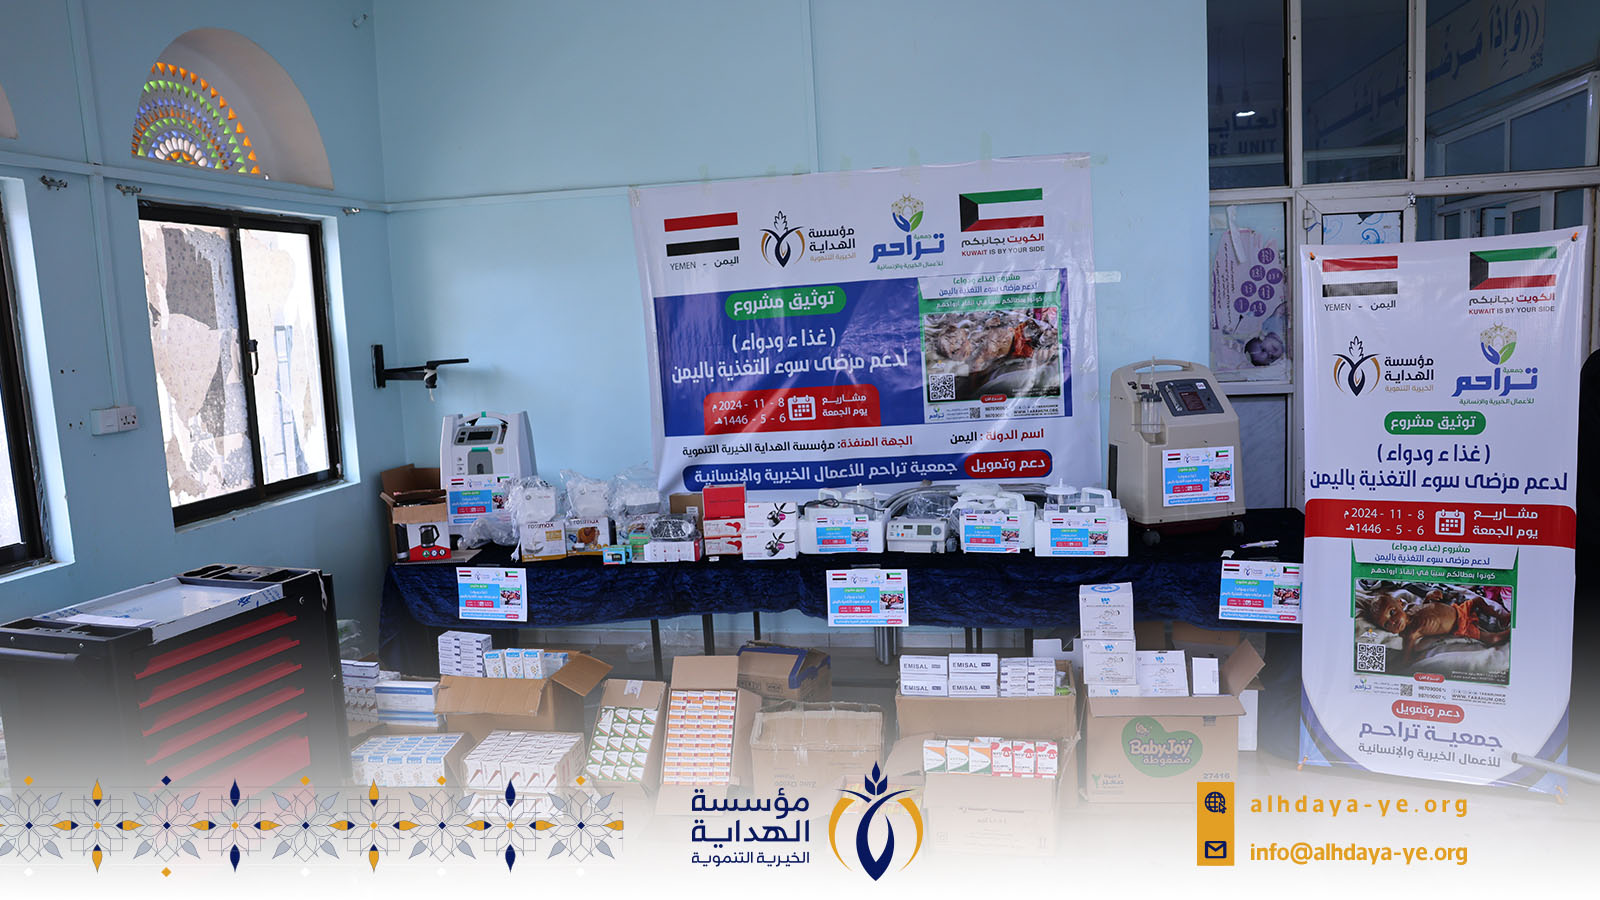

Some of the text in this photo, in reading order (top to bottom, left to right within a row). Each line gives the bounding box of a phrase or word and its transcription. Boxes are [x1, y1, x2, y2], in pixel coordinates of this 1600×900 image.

[1239, 140, 1277, 154] UNIT
[808, 225, 855, 238] مؤسسة
[809, 238, 856, 253] الهداية
[961, 233, 1044, 248] الكويت بجانبكم
[869, 233, 945, 264] تراحم
[961, 249, 987, 257] KUWAIT
[670, 256, 739, 272] YEMEN اليمن
[733, 289, 835, 316] توثيق مشروع
[1324, 300, 1396, 312] YEMEN اليمن
[1469, 293, 1555, 306] الكويت بجانبكم
[870, 348, 908, 373] لدعم
[1384, 354, 1434, 369] مؤسسة
[672, 361, 714, 383] باليمن
[717, 357, 770, 381] التغذية
[774, 358, 809, 378] سوء
[1503, 366, 1524, 374] جمعية
[1384, 369, 1434, 385] الهداية
[1451, 366, 1538, 397] تراحم
[754, 398, 765, 409] 11
[777, 397, 785, 407] 8
[822, 392, 867, 405] مشاريع
[760, 414, 767, 424] 5
[779, 413, 786, 423] 6
[822, 407, 868, 417] يوم الجمعة
[1390, 416, 1476, 431] توثيق مشروع
[881, 435, 913, 447] الجهة
[950, 432, 977, 445] اليمن
[986, 429, 1018, 443] الدولة
[1020, 428, 1044, 441] اسم
[682, 444, 719, 458] التنموية
[721, 443, 752, 455] الخيرية
[754, 441, 790, 454] الهداية
[793, 440, 835, 452] مؤسسة
[814, 463, 864, 483] للأعمال
[869, 461, 906, 479] تراحم
[910, 460, 957, 475] جمعية
[971, 458, 1046, 474] دعم وتمويل
[764, 466, 810, 484] الخيرية
[1310, 468, 1355, 490] باليمن
[1359, 469, 1416, 491] التغذية
[1421, 475, 1460, 493] سوء
[1524, 472, 1568, 495] لدعم
[1390, 509, 1402, 519] 11
[1417, 510, 1425, 520] 8
[1473, 507, 1538, 521] مشاريع
[1395, 524, 1402, 535] 5
[1417, 525, 1424, 536] 6
[1472, 525, 1538, 539] يوم الجمعة
[1391, 543, 1470, 553] مشروع (غذاء ودواء)
[1375, 553, 1396, 562] باليمن
[1398, 554, 1424, 563] التغذية
[1426, 556, 1443, 564] سوء
[1471, 557, 1490, 566] لدعم
[1395, 703, 1460, 718] دعم وتمويل
[1359, 721, 1503, 752] جمعية تراحم
[1416, 750, 1456, 762] الخيرية
[1458, 754, 1501, 768] للأعمال
